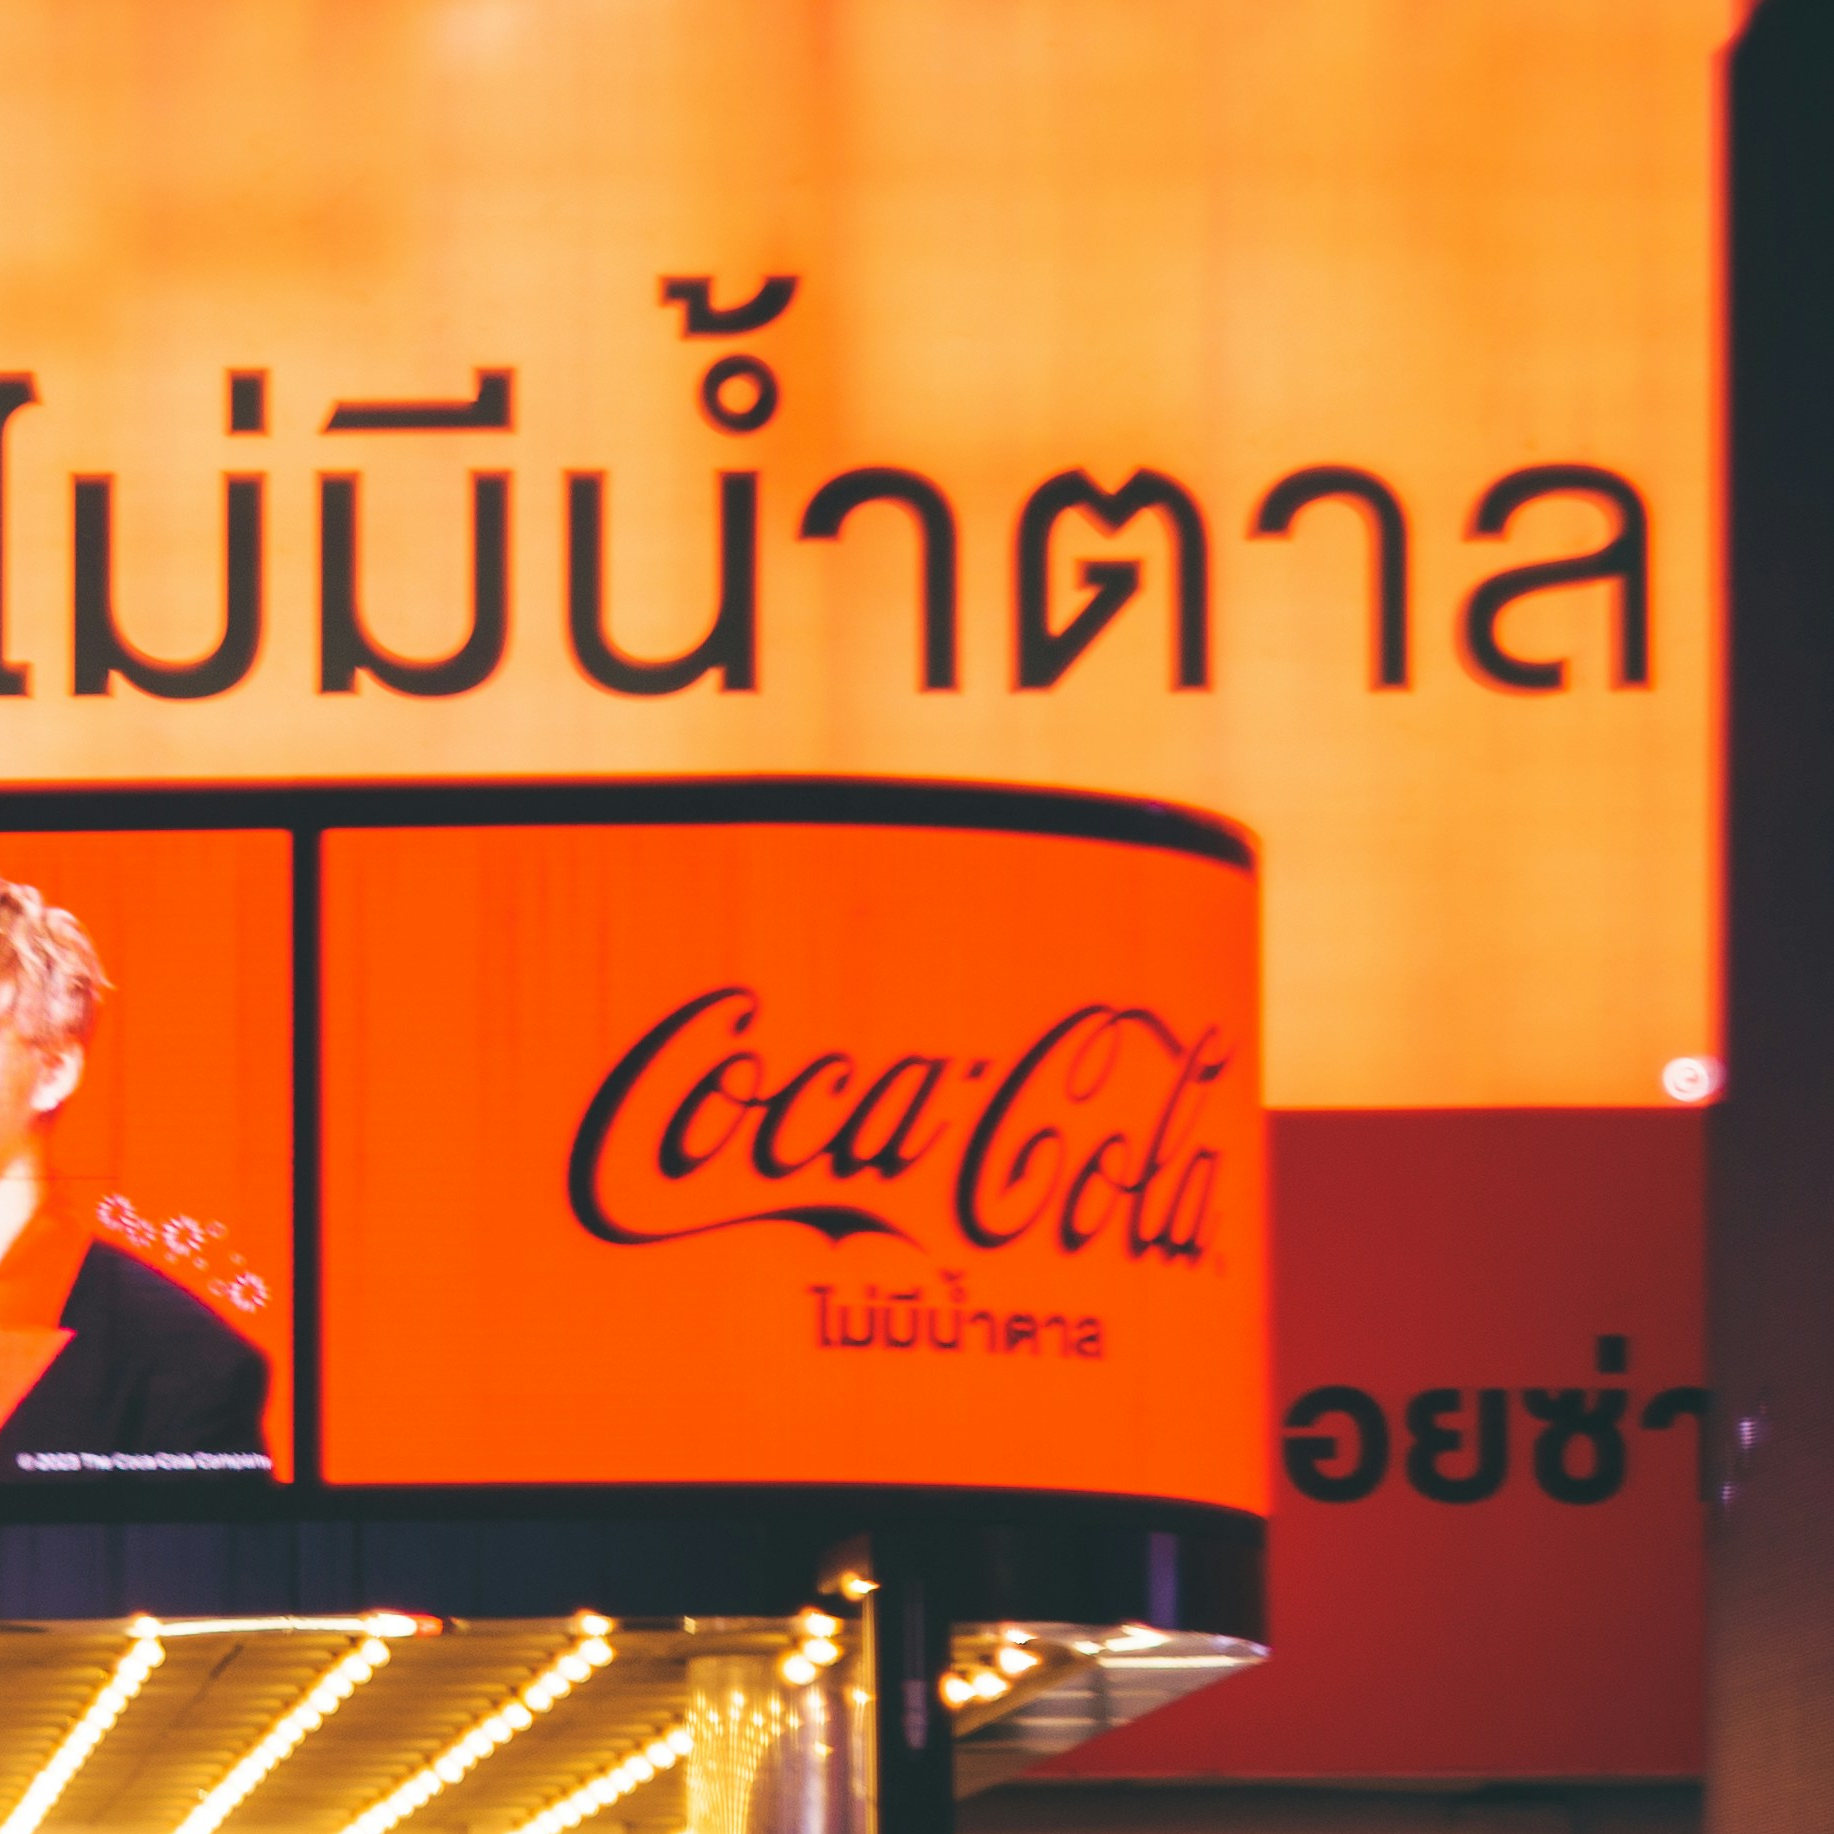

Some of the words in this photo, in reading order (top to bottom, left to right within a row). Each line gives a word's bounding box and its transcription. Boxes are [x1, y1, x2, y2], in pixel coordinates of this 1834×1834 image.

[566, 986, 1236, 1264] Coca-Cola
[806, 1270, 1107, 1360] ไม่มีน้ำตาล
